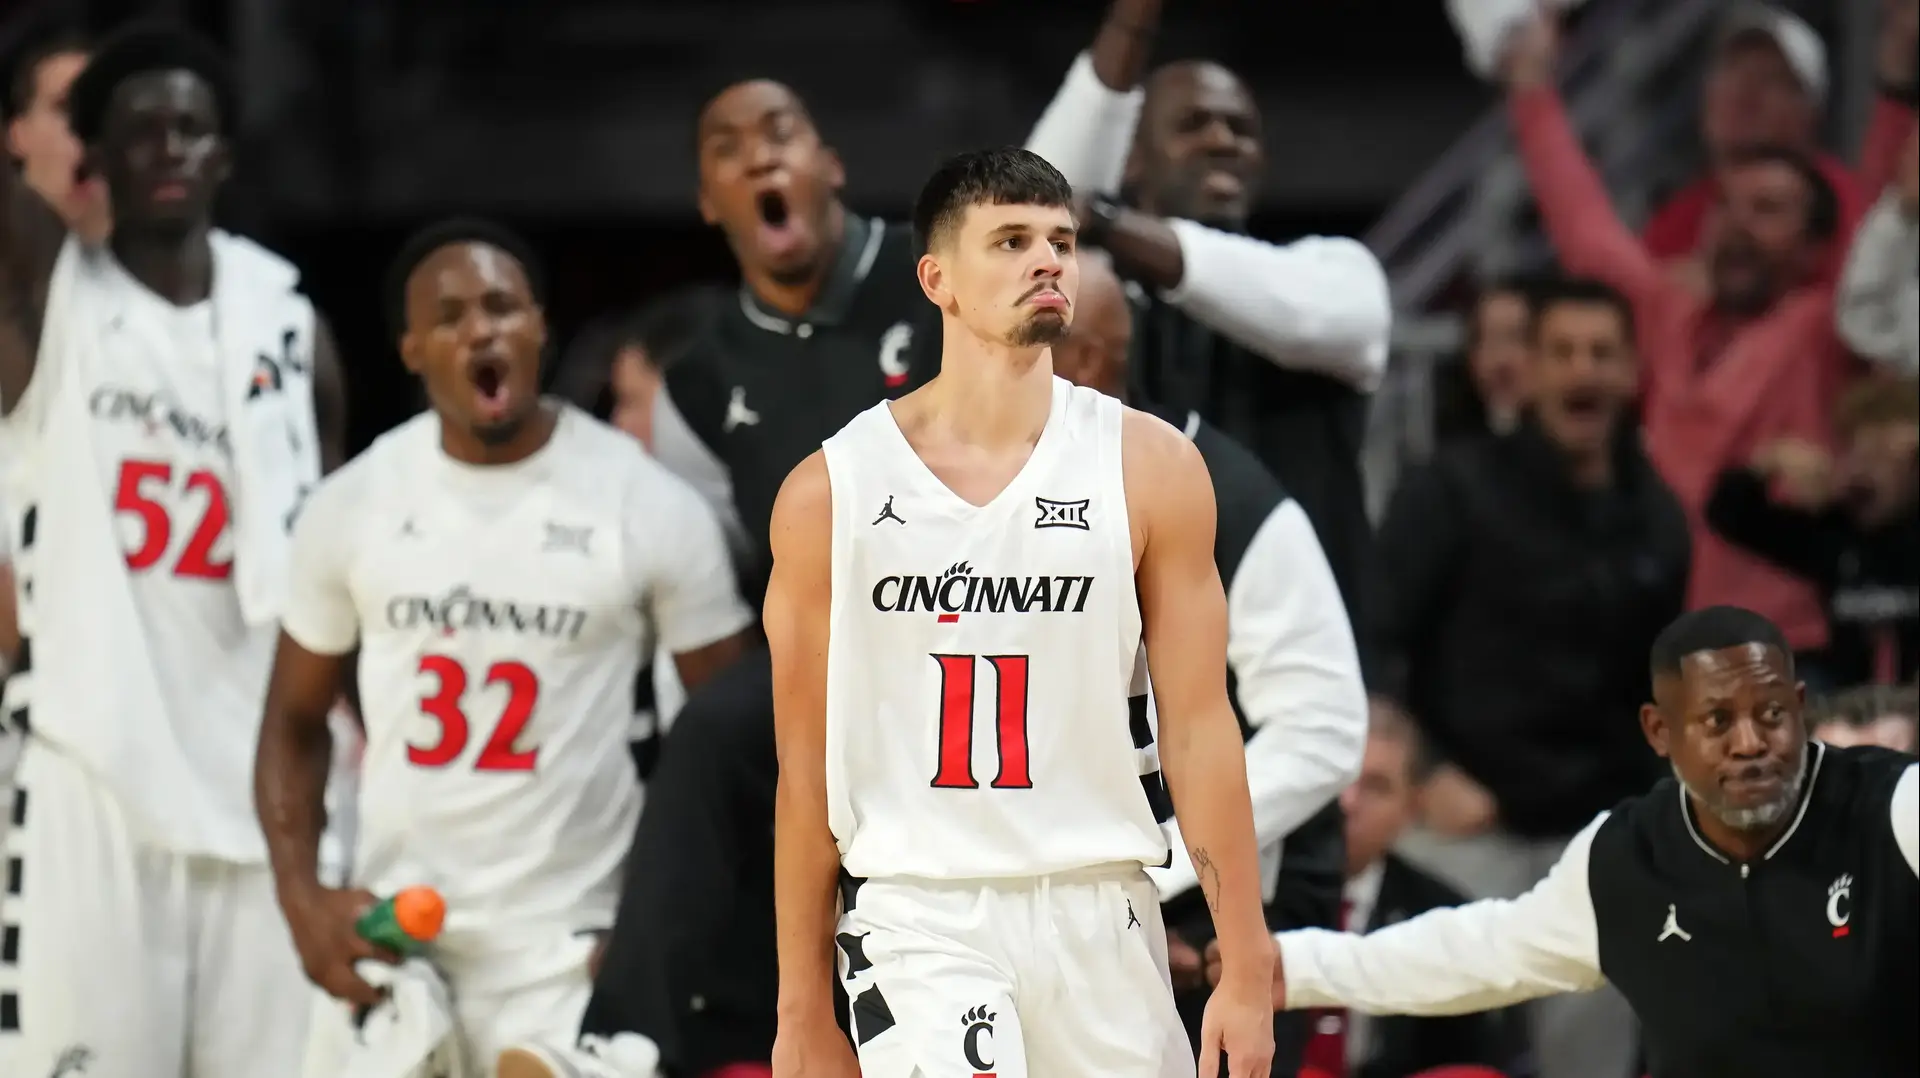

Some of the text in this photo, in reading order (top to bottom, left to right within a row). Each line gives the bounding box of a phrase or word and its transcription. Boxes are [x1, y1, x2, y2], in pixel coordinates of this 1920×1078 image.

[115, 459, 234, 581] 52
[872, 568, 1095, 617] CINCINNATI
[405, 653, 541, 774] 32
[929, 653, 1033, 789] 11
